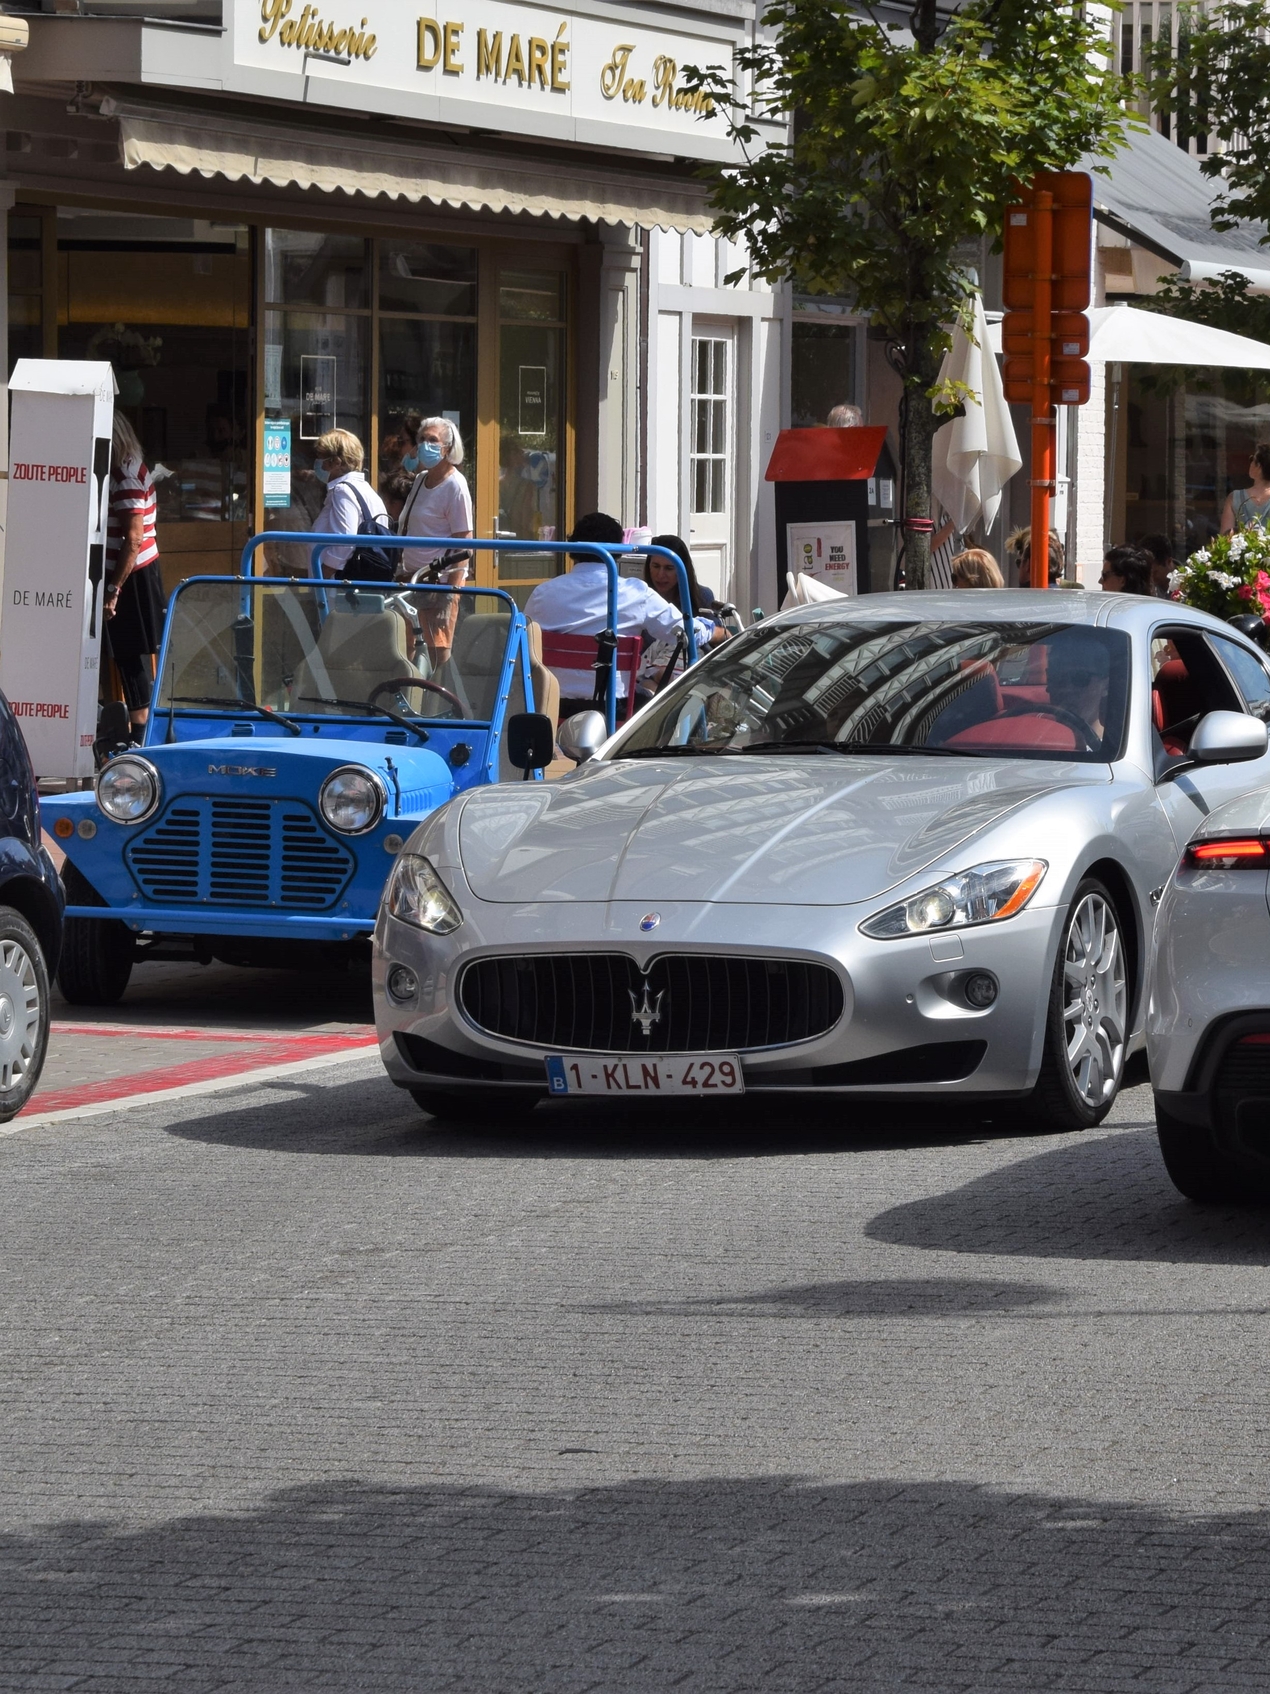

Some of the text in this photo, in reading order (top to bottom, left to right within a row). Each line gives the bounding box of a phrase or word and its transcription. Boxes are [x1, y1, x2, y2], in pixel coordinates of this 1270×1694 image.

[258, 0, 377, 59] Patisserie
[417, 17, 570, 92] DE MARÉ
[600, 44, 647, 101] Tea
[13, 463, 87, 484] ZOUTE PEOPLE
[829, 554, 846, 562] NEED
[830, 545, 844, 554] YOU
[825, 562, 850, 571] ENERGY
[13, 590, 73, 608] DE MARÉ
[35, 702, 69, 719] PEOPLE
[208, 764, 277, 777] MOKE
[553, 1077, 565, 1090] B
